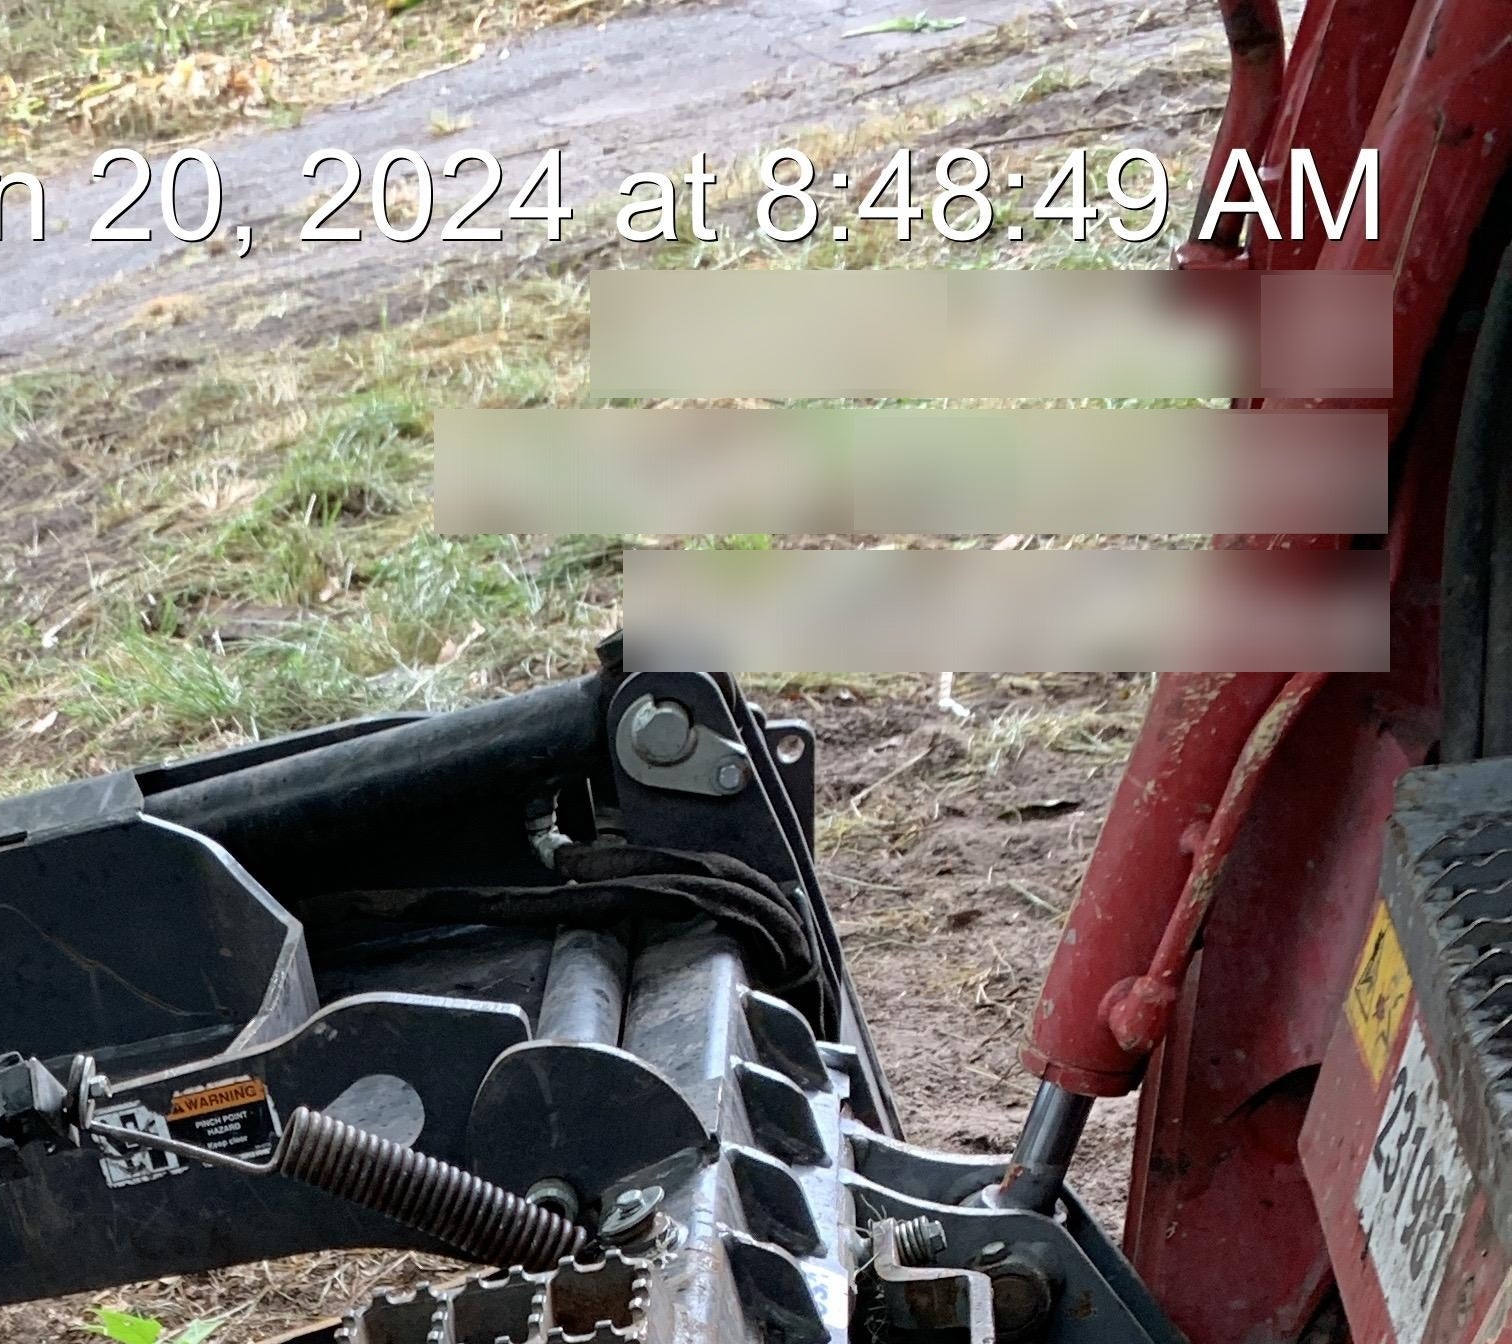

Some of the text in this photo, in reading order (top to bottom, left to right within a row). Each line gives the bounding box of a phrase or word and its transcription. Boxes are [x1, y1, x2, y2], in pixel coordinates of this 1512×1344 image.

[183, 1085, 257, 1111] WARNING
[195, 1110, 248, 1129] PINCH POINT
[207, 1122, 241, 1136] HAZARD
[229, 1135, 248, 1146] clear
